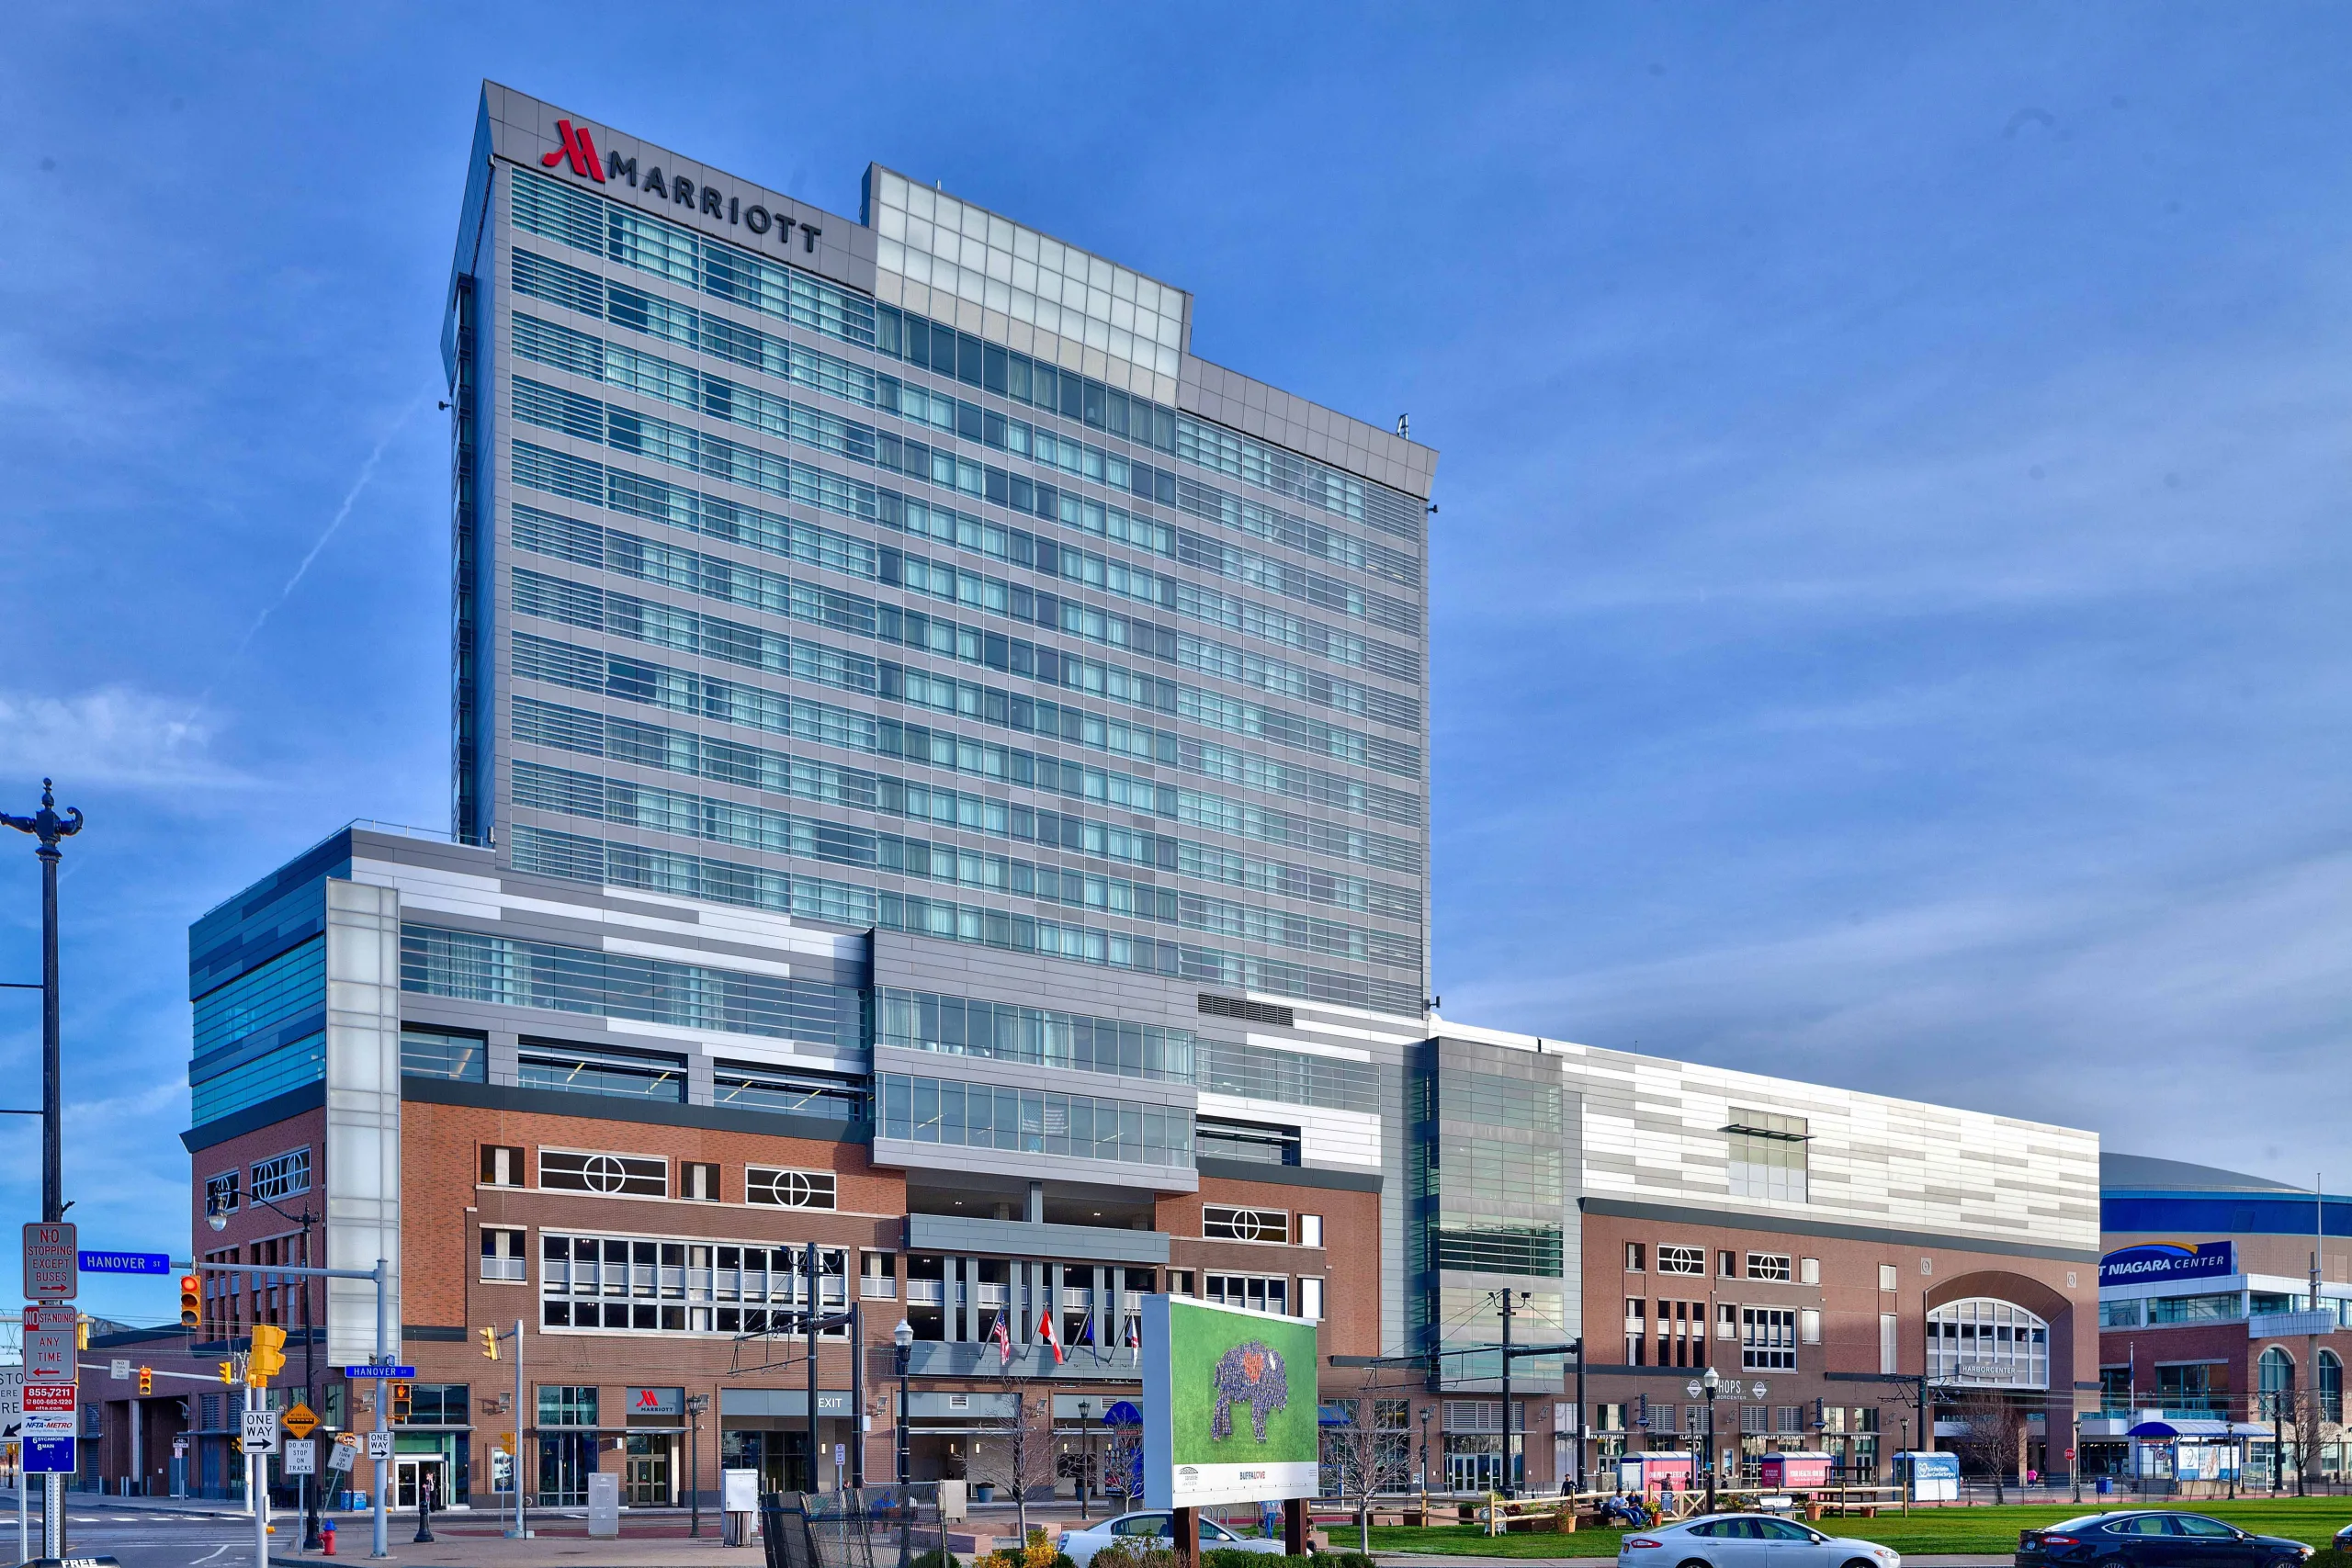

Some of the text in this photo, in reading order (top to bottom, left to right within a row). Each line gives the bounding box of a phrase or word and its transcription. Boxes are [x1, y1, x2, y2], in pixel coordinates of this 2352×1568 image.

[609, 150, 822, 253] MARRIOTT
[40, 1229, 60, 1243] NO
[28, 1246, 73, 1256] STOPPING
[32, 1259, 70, 1269] EXCEPT
[86, 1256, 145, 1269] HANOVER
[2109, 1258, 2171, 1276] NIAGARA
[2174, 1256, 2224, 1269] CENTER
[36, 1272, 67, 1281] BUSES
[25, 1311, 74, 1325] NO STANDING
[40, 1337, 60, 1347] ANY
[38, 1352, 62, 1361] TIME
[354, 1368, 396, 1376] HANOVER
[1962, 1365, 2016, 1374] HARBORCENTER
[0, 1372, 23, 1385] STO
[1715, 1380, 1741, 1393] HOPS
[28, 1388, 70, 1397] 855-7211
[818, 1398, 842, 1408] EXIT
[2, 1403, 20, 1414] RE
[246, 1415, 273, 1425] ONE
[246, 1427, 273, 1436] WAY
[60, 1559, 97, 1568] FREE
